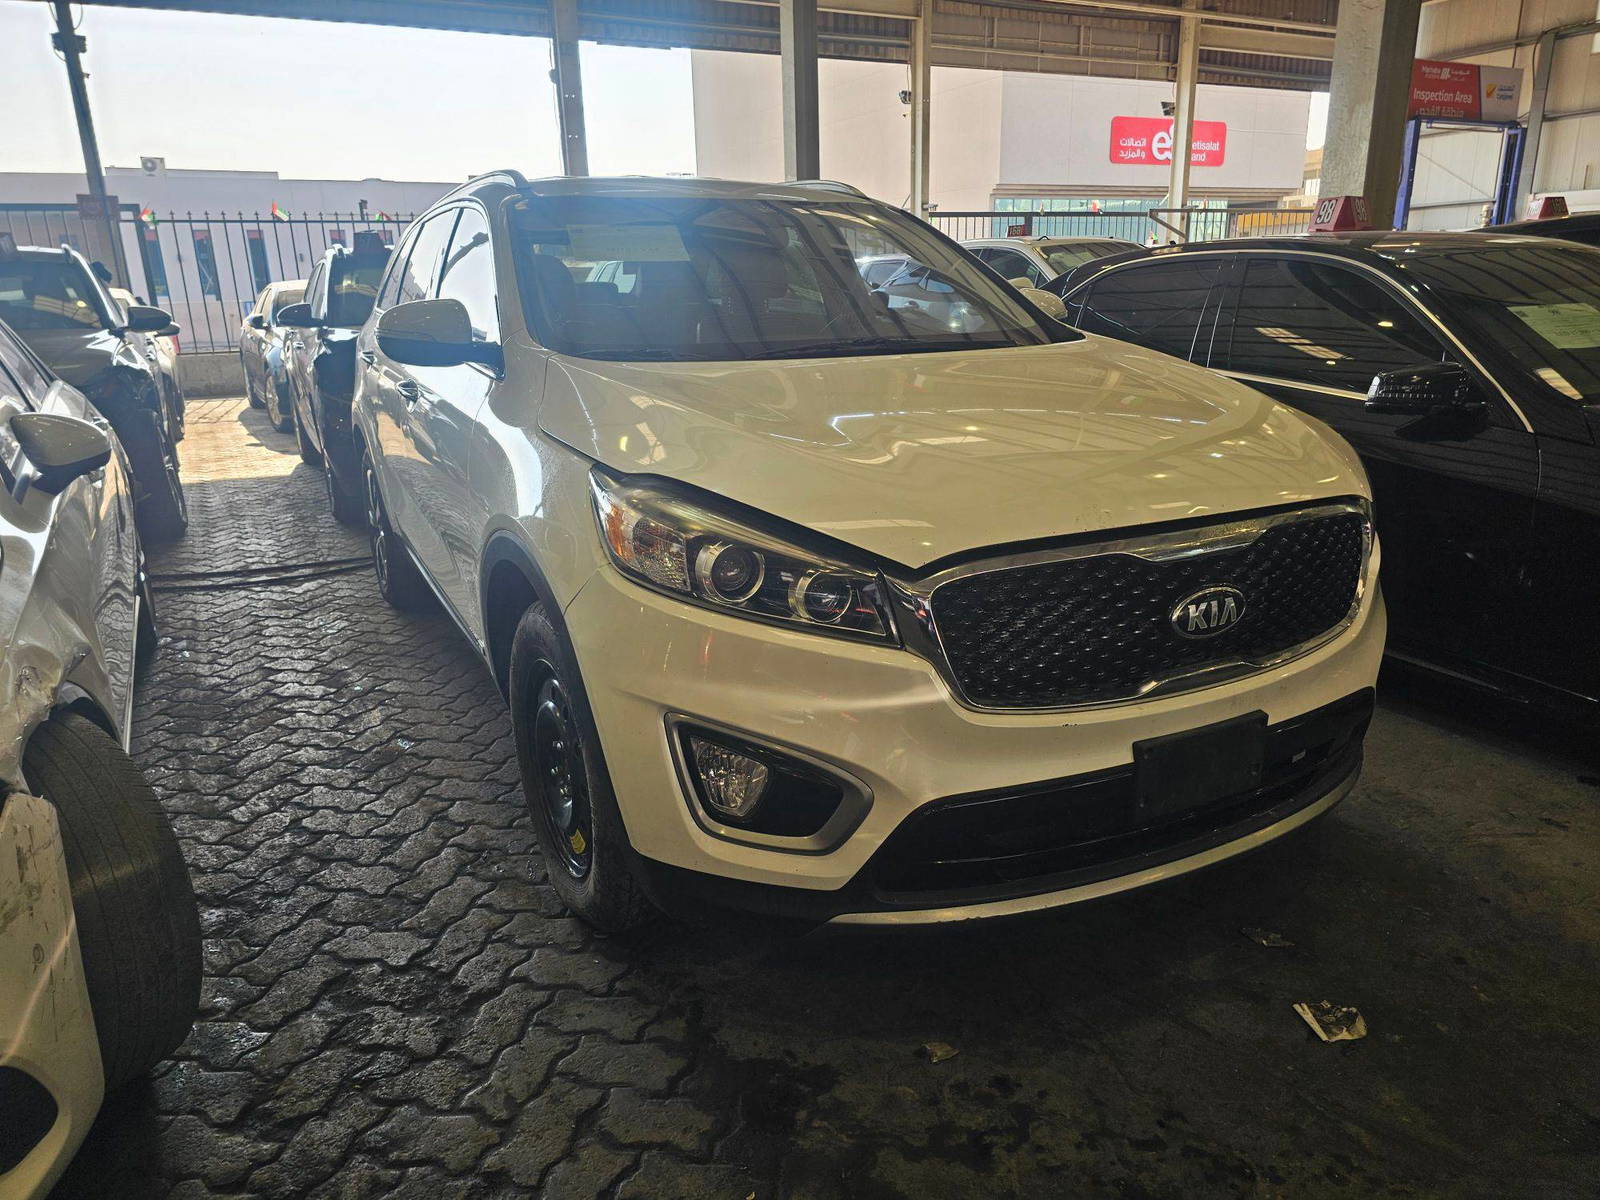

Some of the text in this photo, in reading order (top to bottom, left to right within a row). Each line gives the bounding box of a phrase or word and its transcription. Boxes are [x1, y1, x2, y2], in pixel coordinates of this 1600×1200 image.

[1413, 87, 1472, 104] Inspection Area
[1119, 137, 1147, 147] اتصالات
[1191, 141, 1220, 152] etisalat
[1119, 149, 1146, 160] والمزيد
[1191, 151, 1206, 162] and
[1316, 199, 1337, 224] 98
[1187, 597, 1237, 632] KIA
